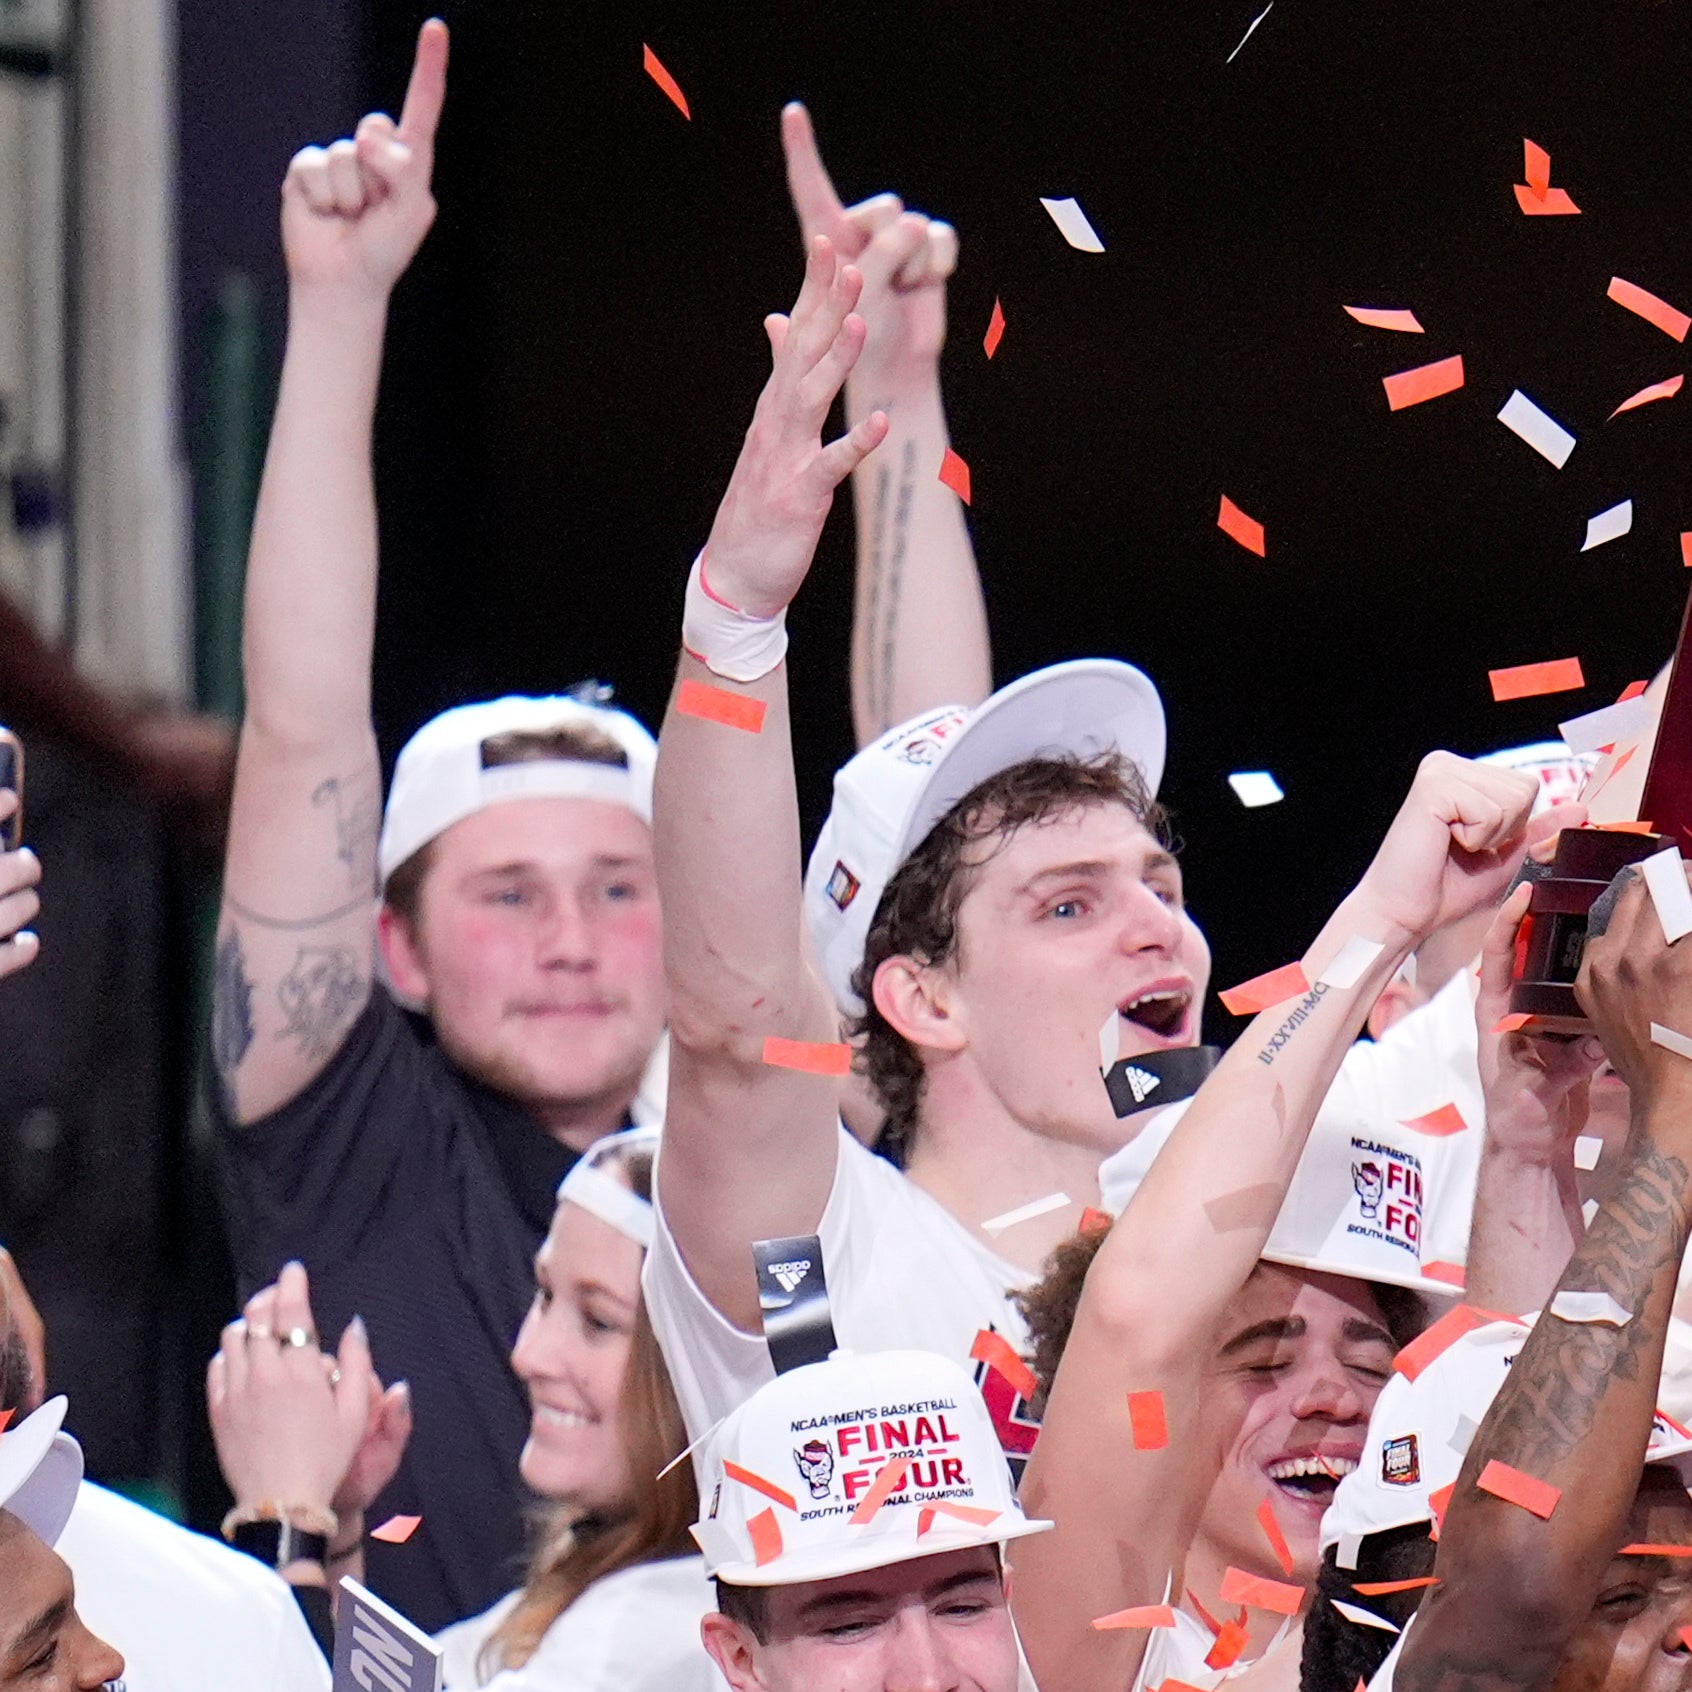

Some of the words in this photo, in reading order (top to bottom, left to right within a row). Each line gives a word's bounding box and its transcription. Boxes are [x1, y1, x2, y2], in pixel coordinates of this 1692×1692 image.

[1387, 1161, 1424, 1207] FIN
[1385, 1204, 1422, 1243] FO
[766, 1260, 812, 1276] adidas
[881, 1398, 957, 1418] BASKETBALL
[837, 1414, 960, 1457] FINAL
[889, 1448, 925, 1461] 2024
[800, 1504, 844, 1522] SOUTH
[846, 1493, 913, 1515] RONAL
[913, 1487, 975, 1502] CHAMPIONS
